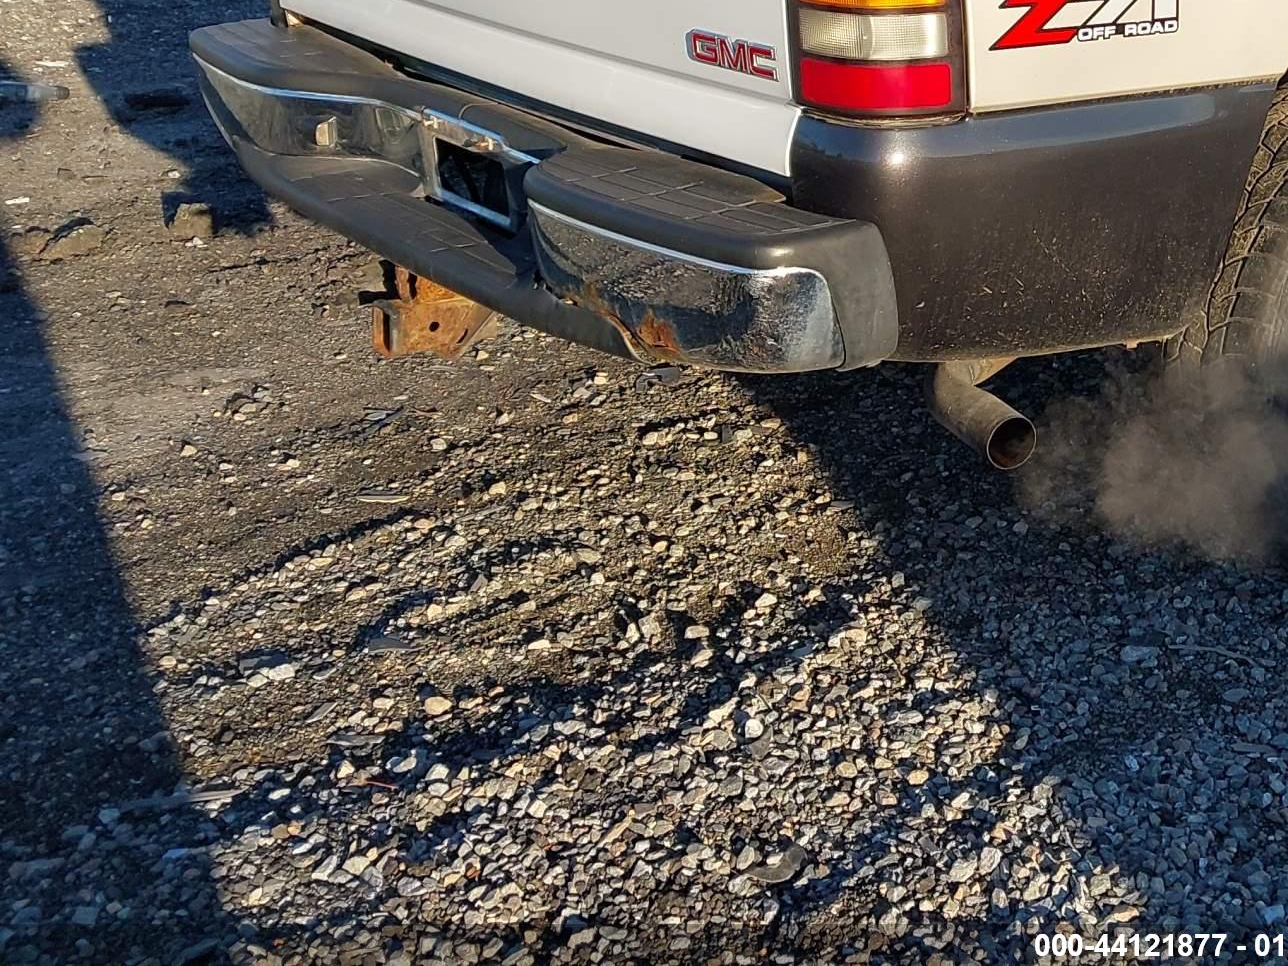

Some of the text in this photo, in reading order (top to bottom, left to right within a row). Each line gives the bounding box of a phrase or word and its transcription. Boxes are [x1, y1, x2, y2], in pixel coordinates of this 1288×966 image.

[1077, 19, 1179, 43] OFF ROAD
[685, 27, 780, 83] GMC
